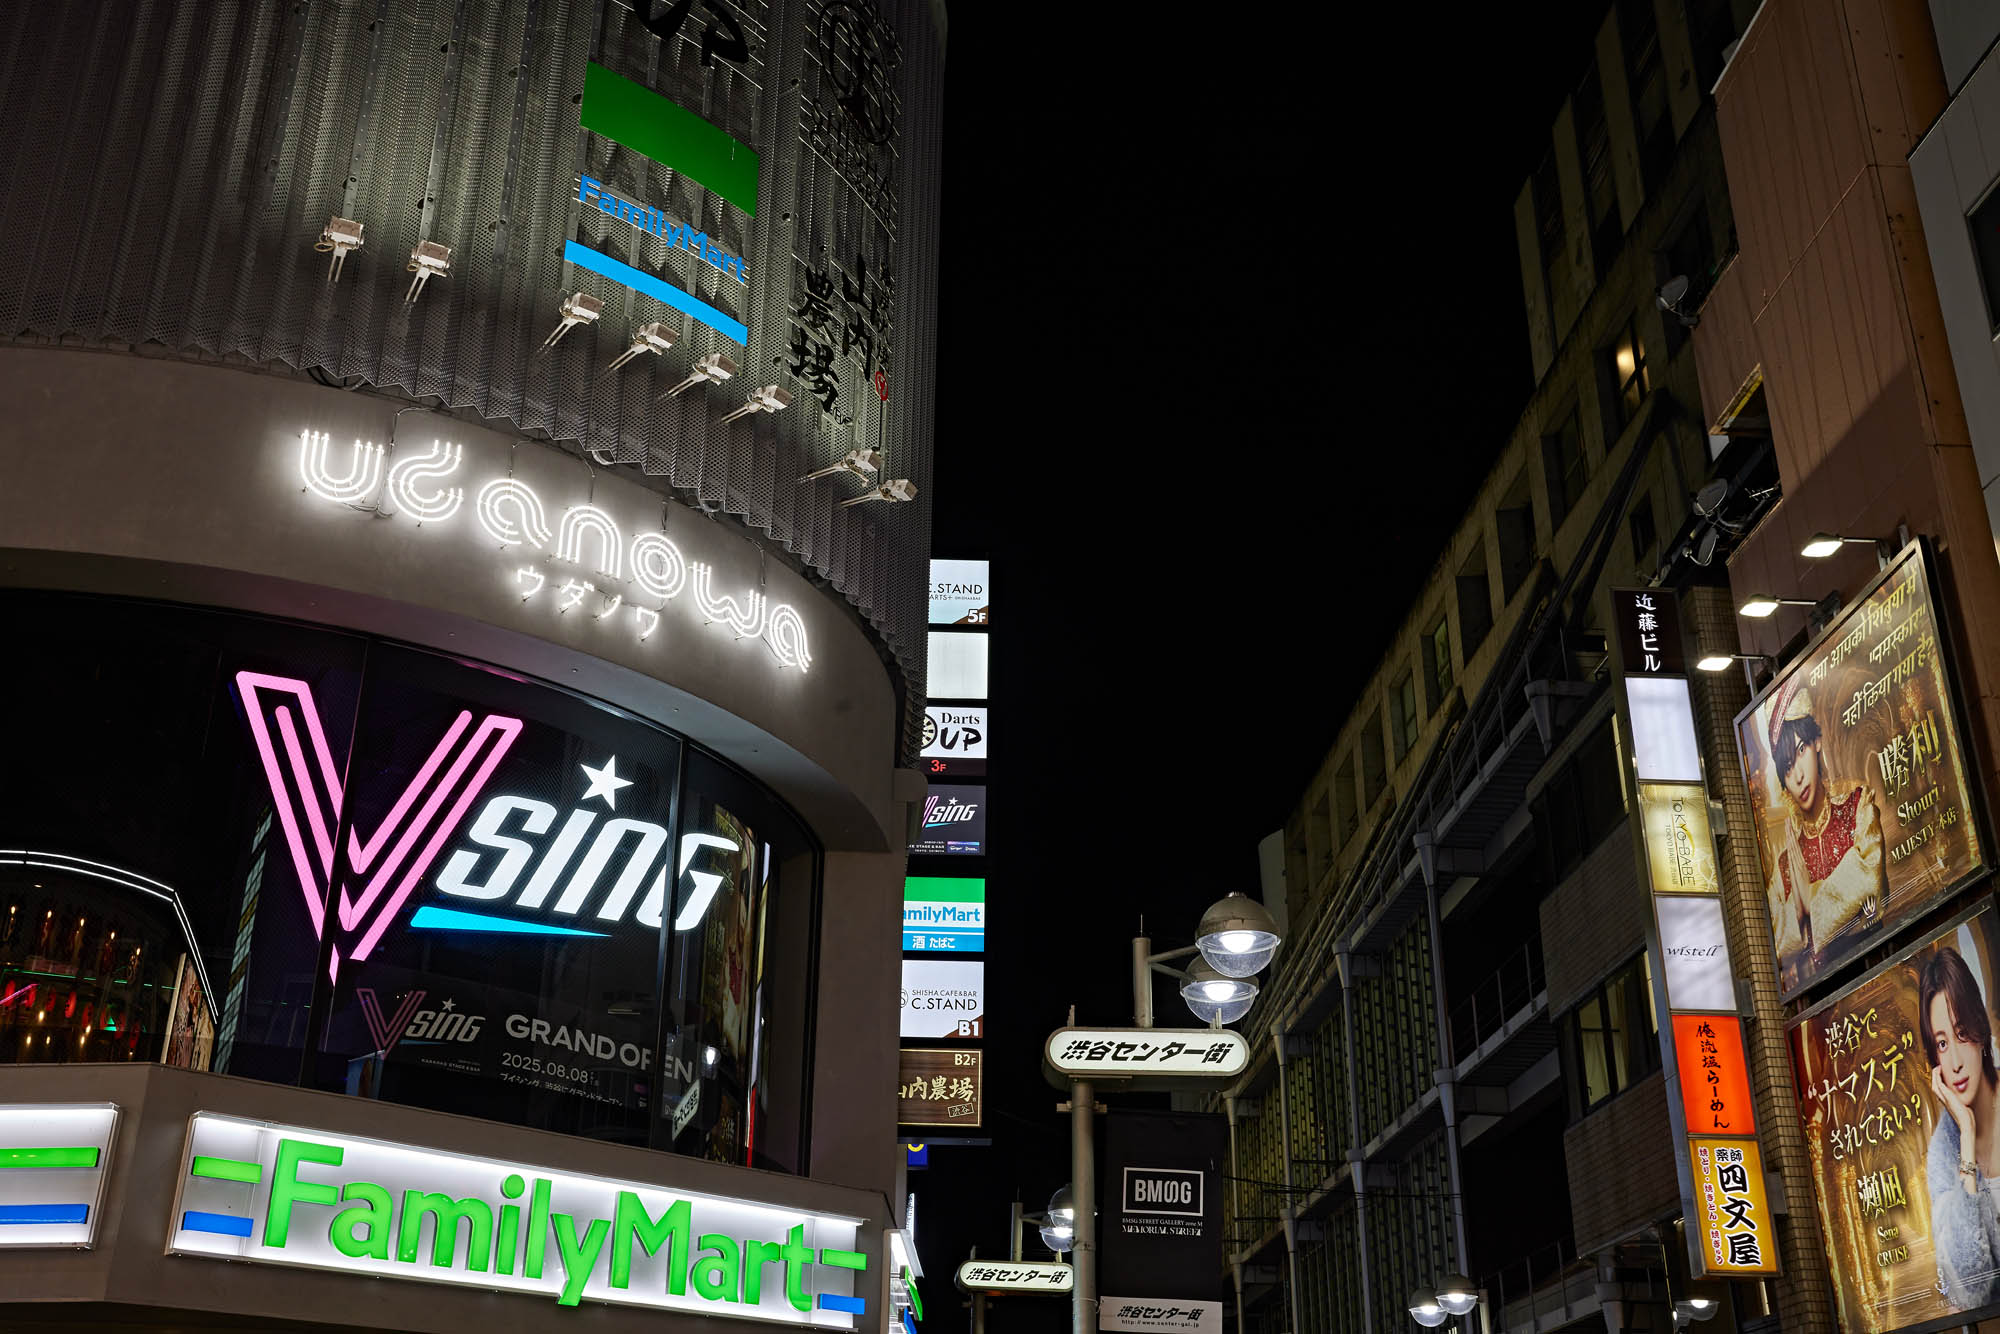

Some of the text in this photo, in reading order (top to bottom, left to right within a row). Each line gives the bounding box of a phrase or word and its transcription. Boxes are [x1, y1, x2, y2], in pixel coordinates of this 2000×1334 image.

[579, 175, 749, 284] FamilyMart
[517, 566, 660, 640] ウダノワ
[967, 610, 986, 623] 5F
[1635, 593, 1661, 672] 近藤ビル
[1810, 655, 1828, 687] क्या
[1830, 613, 1865, 668] आपको
[1842, 690, 1862, 727] नहीं
[1863, 671, 1892, 713] किया
[1893, 650, 1916, 683] गया
[941, 712, 980, 725] Darts
[940, 728, 982, 751] UP
[931, 760, 946, 771] 3F
[1878, 710, 1942, 797] 勝利
[1897, 780, 1940, 827] Shouri
[1891, 824, 1934, 863] MAJESTY
[912, 936, 956, 948] 酒 たばこ
[1667, 945, 1724, 956] wistell
[912, 998, 977, 1010] C.STAND
[505, 1014, 616, 1060] GRAND
[959, 1020, 979, 1036] B1
[1825, 1008, 1878, 1059] 渋谷で
[954, 1054, 976, 1066] B2F
[1060, 1039, 1235, 1064] 渋谷センター街
[502, 1052, 588, 1084] 2025.08.08
[1696, 1021, 1729, 1128] 俺流塩らーめん
[1716, 1149, 1742, 1162] 薬師
[262, 1139, 816, 1306] FamilyMart
[1717, 1164, 1761, 1265] 四文屋
[1877, 1226, 1899, 1243] Sena
[1877, 1245, 1909, 1267] CRUISE
[966, 1267, 1068, 1284] 渋谷センター街
[1117, 1306, 1204, 1320] 渋谷センター街
